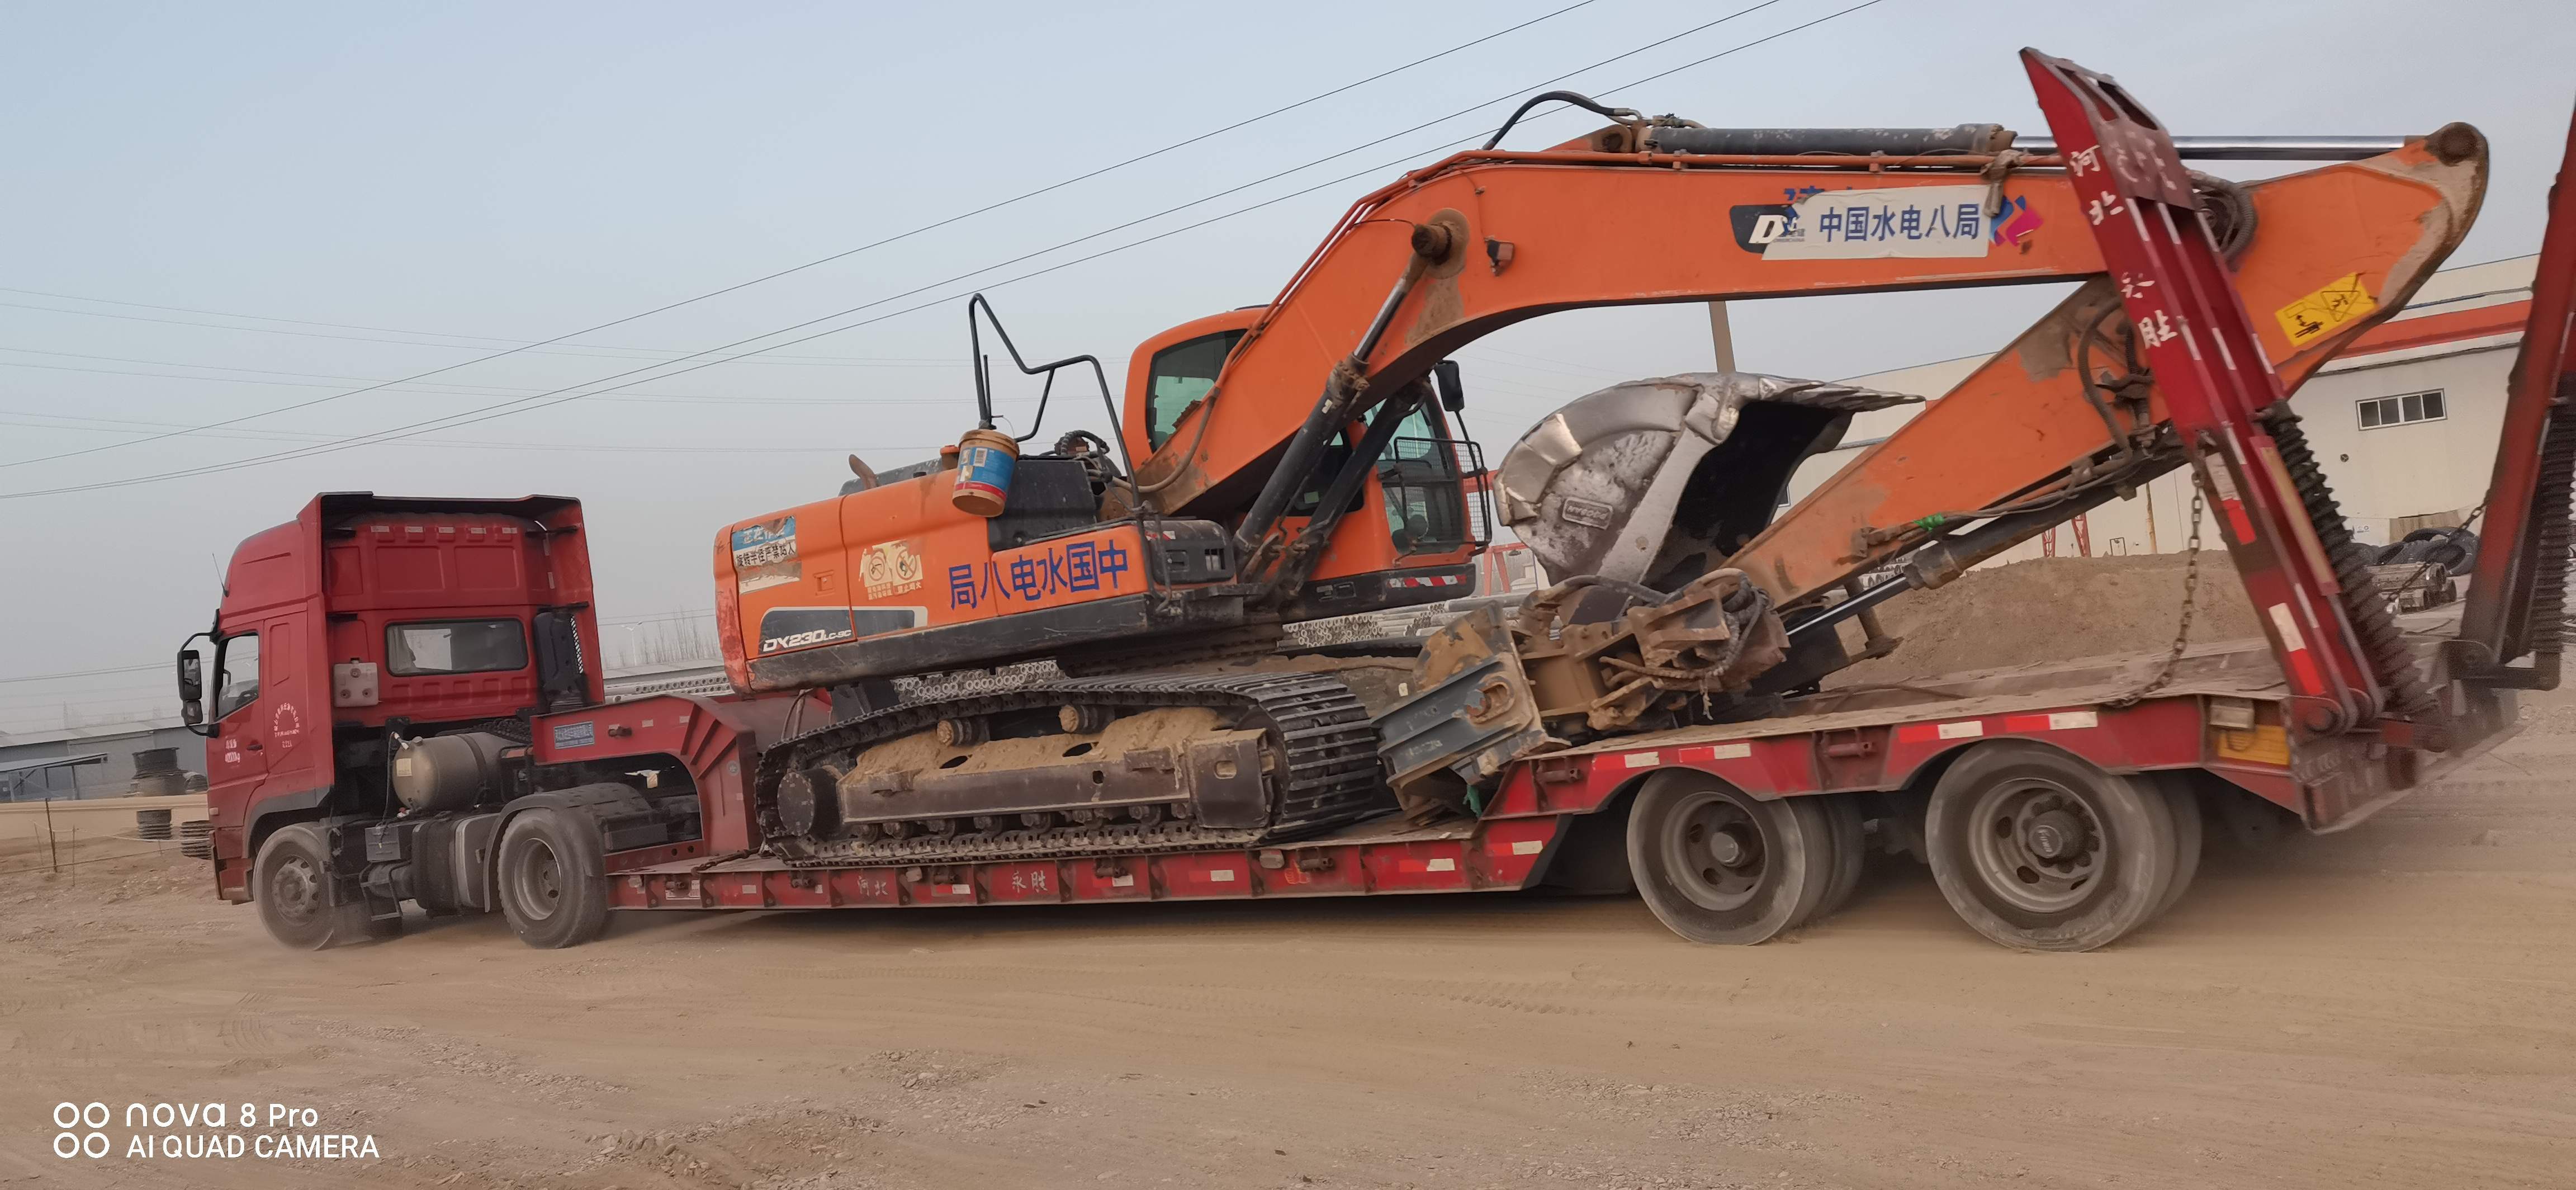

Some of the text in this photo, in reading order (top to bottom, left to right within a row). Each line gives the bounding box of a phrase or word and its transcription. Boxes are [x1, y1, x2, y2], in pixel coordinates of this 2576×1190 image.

[1819, 204, 1980, 243] 中国水电八局
[857, 870, 1049, 896] 河北 永胜
